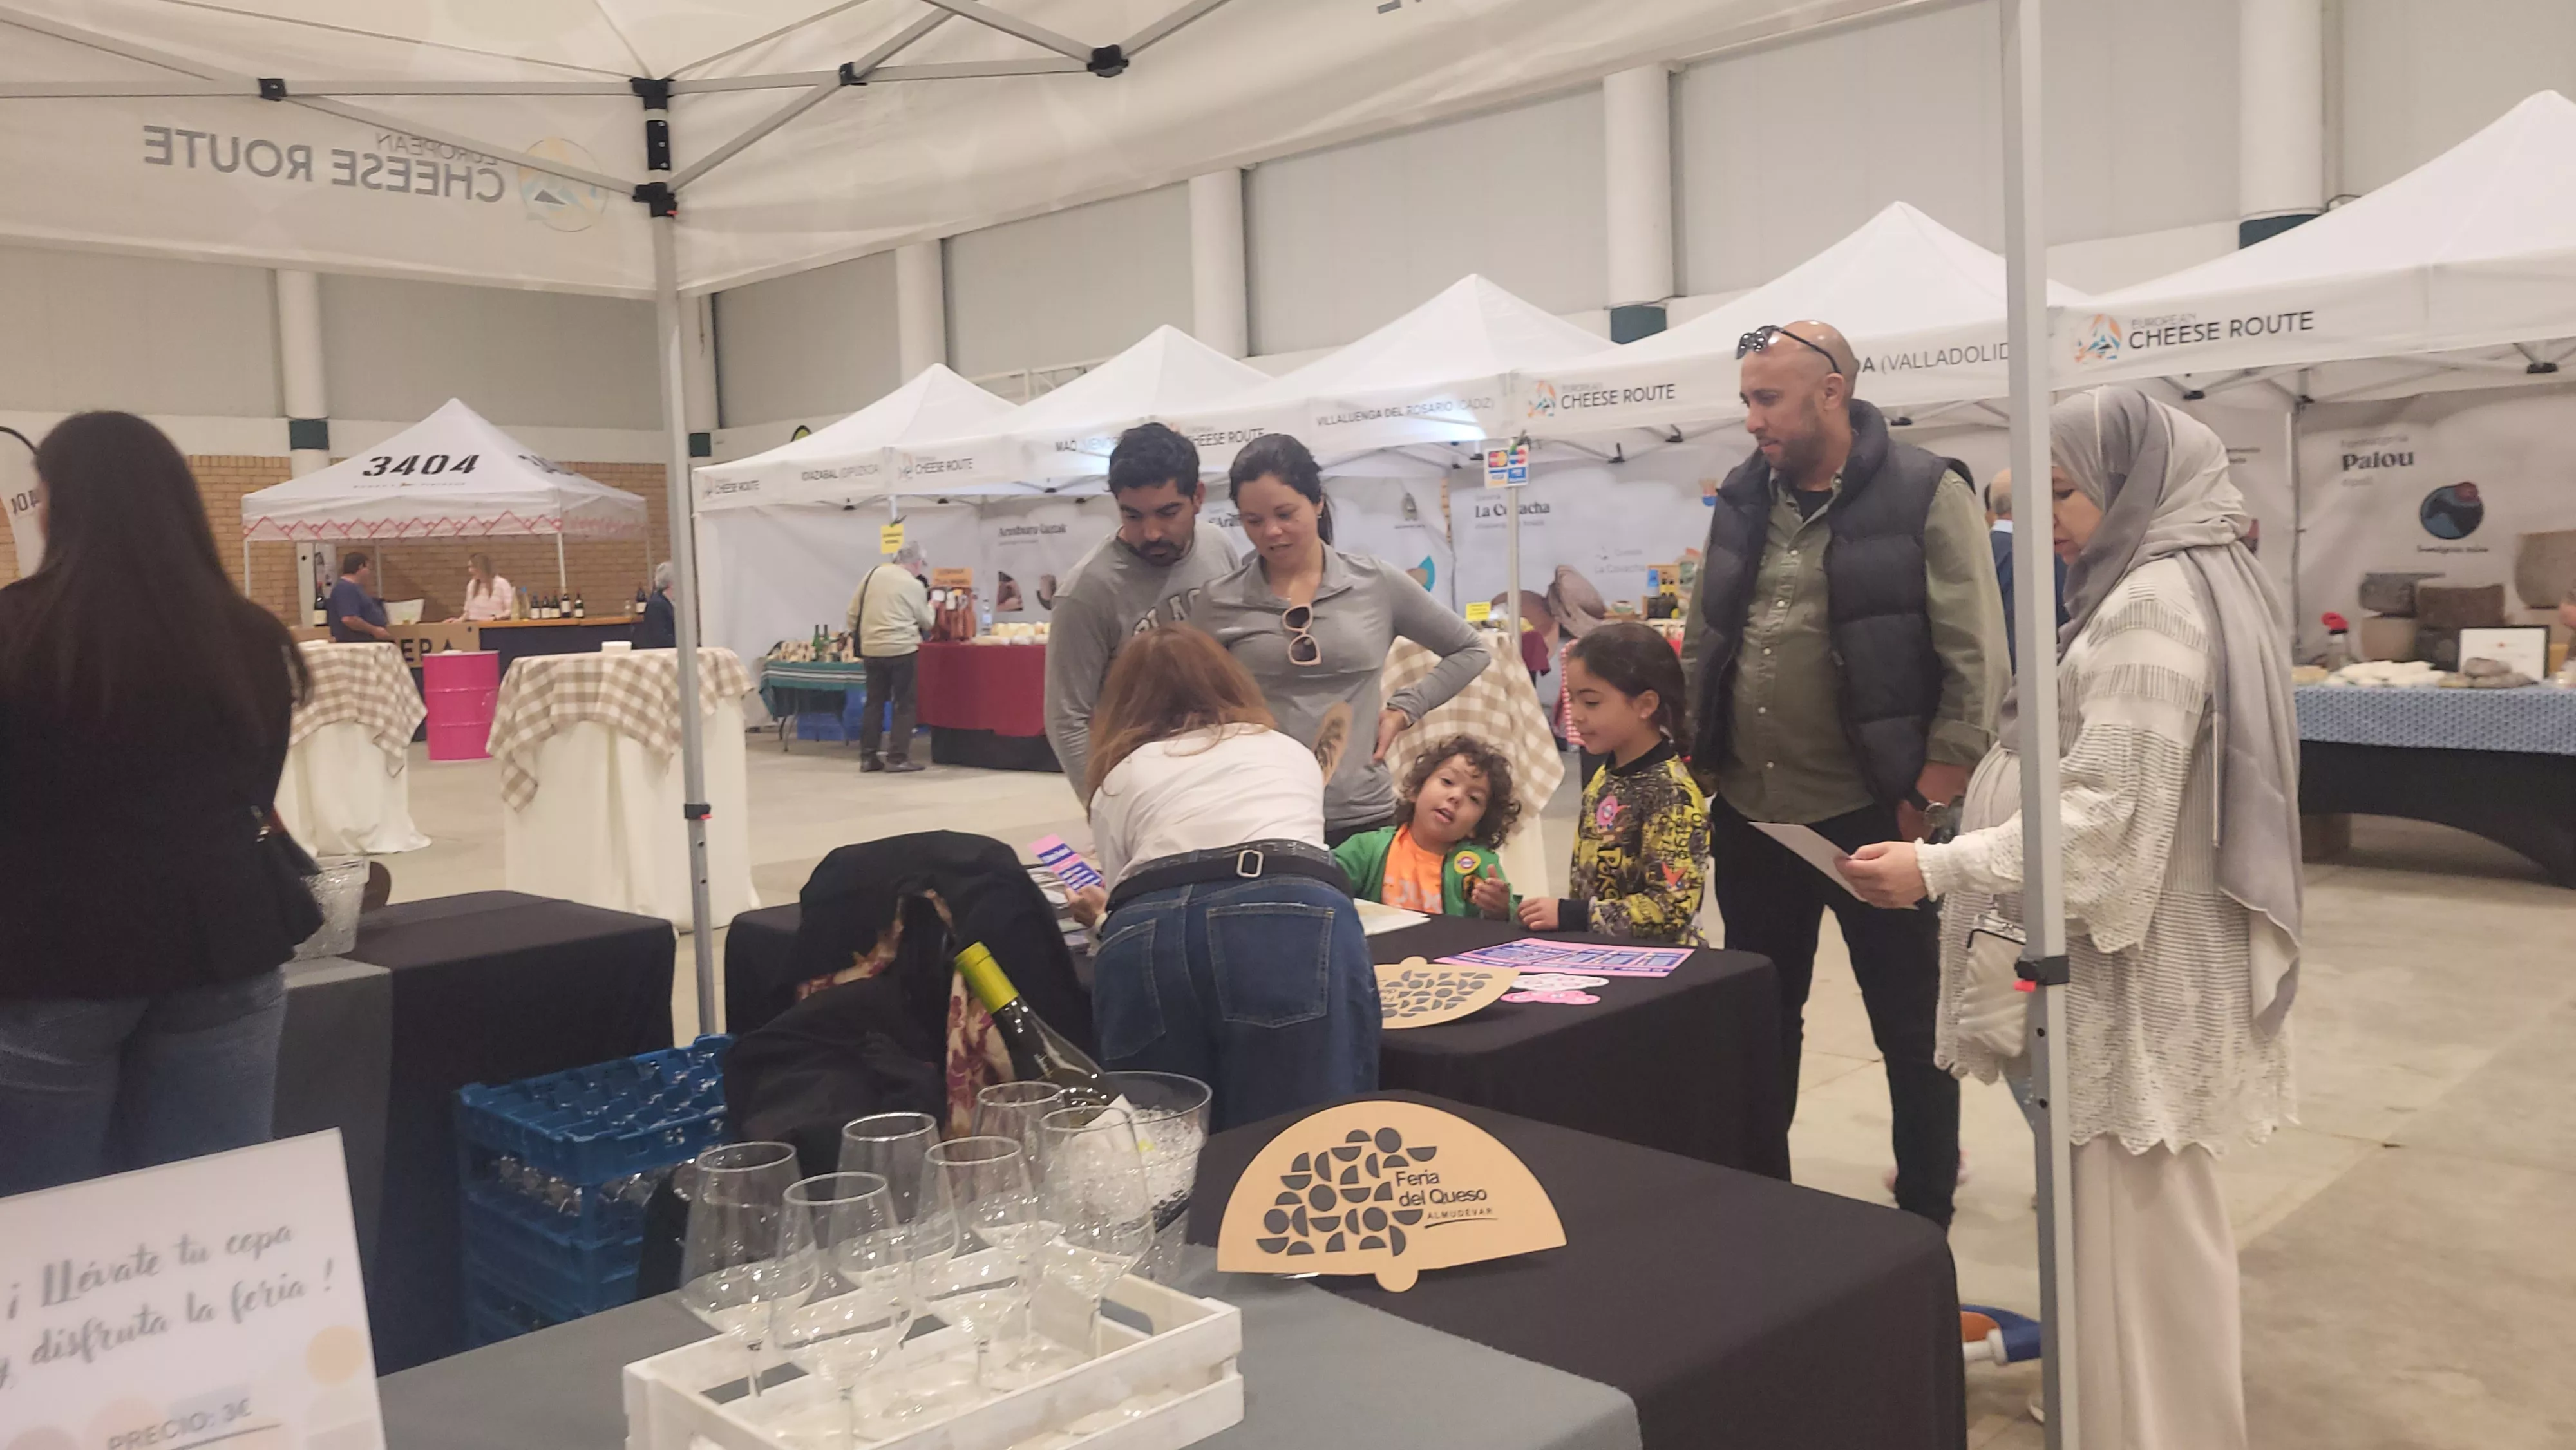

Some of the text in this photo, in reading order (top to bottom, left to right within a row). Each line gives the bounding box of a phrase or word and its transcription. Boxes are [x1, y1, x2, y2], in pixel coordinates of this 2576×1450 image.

[2128, 310, 2315, 349] CHEESE ROUTE
[1561, 384, 1676, 410] CHEESE ROUTE
[1385, 406, 1405, 418] DEL
[362, 454, 480, 476] 3404
[915, 461, 944, 474] CHEESE
[946, 458, 974, 471] ROUTE
[1475, 502, 1551, 518] La Cacha
[1395, 1169, 1440, 1187] Feria
[1399, 1188, 1488, 1207] del Queso
[173, 1234, 212, 1268] tu
[31, 1303, 171, 1366] disfruta
[186, 1291, 216, 1324] la
[229, 1272, 307, 1324] feria
